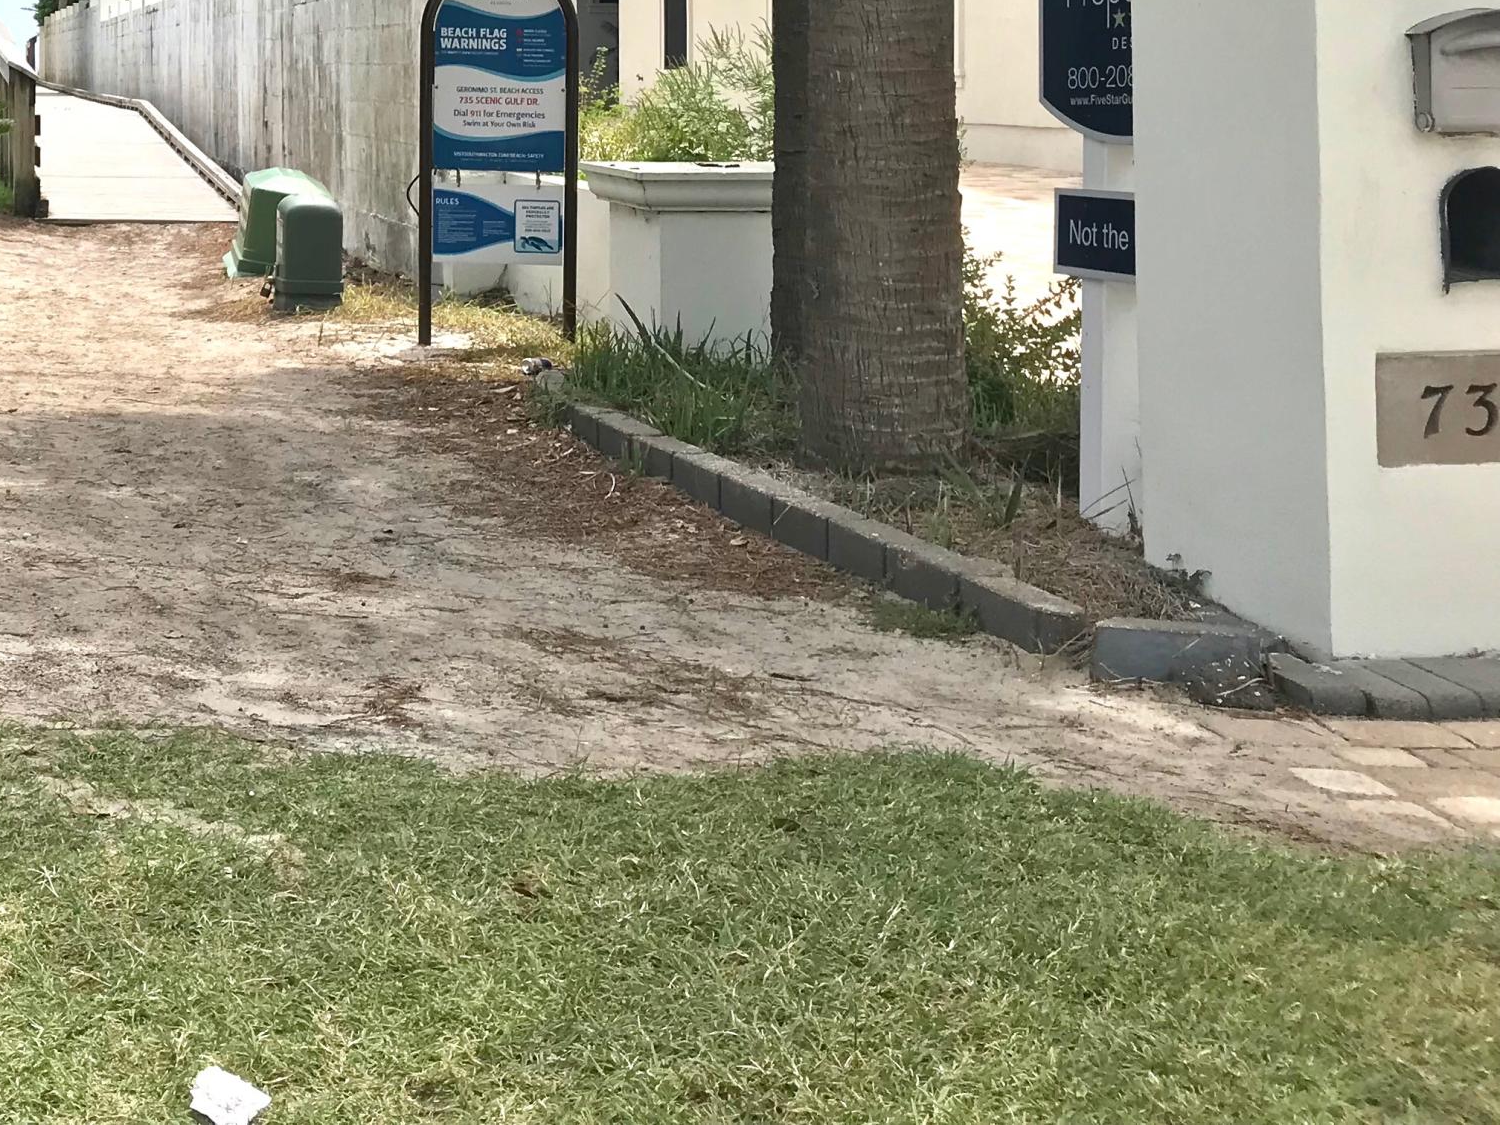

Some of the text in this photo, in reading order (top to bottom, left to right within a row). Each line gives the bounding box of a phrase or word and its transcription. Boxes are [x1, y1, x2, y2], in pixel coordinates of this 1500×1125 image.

[440, 27, 507, 38] BEACH FLAG
[440, 37, 507, 50] WARNINGS
[456, 86, 489, 94] GERONIMO
[521, 87, 544, 95] ACCESS
[459, 96, 540, 106] 735 SCENIC GULF DR.
[453, 109, 469, 117] Dial
[483, 109, 495, 118] for
[496, 110, 546, 121] Emergencies
[462, 119, 481, 127] Swim
[490, 120, 504, 128] Your
[435, 197, 460, 205] RULES
[1069, 219, 1129, 250] Not the
[1420, 382, 1499, 439] 73
